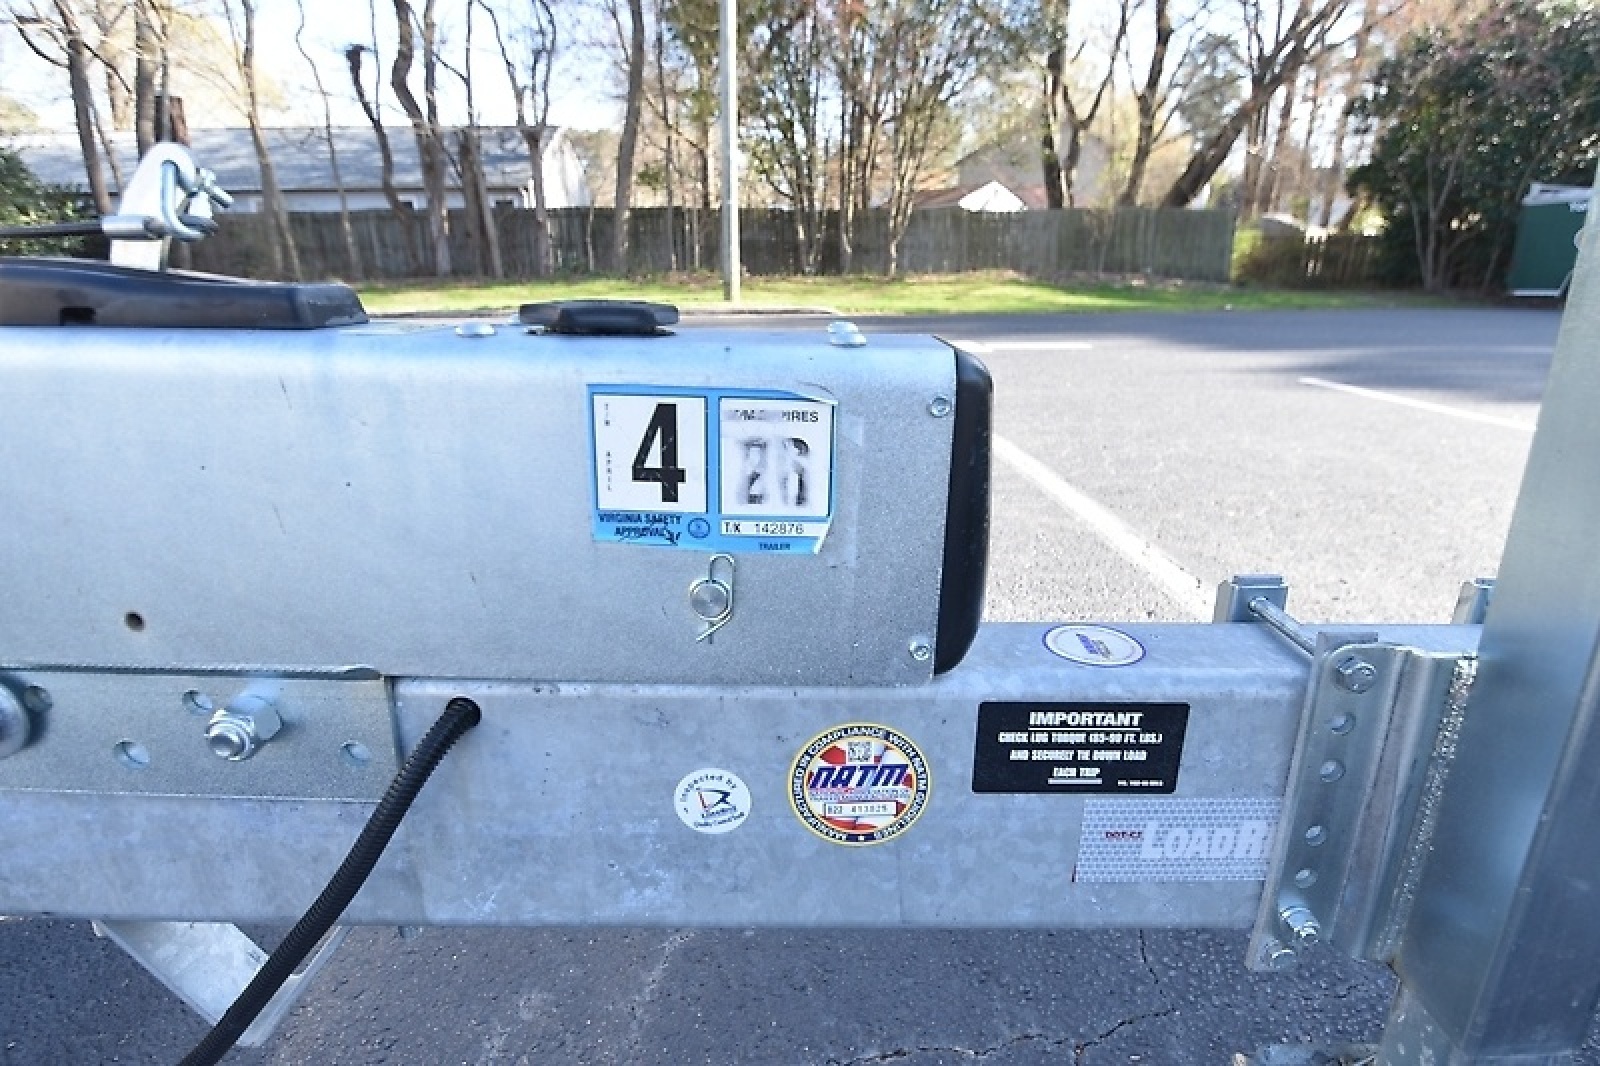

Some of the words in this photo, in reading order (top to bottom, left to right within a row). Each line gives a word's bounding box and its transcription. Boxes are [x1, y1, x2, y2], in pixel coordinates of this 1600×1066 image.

[631, 401, 686, 503] 4
[598, 513, 642, 523] VIRGINIA
[643, 513, 682, 525] SAFETY
[753, 523, 805, 535] 142876
[758, 541, 791, 551] TRAILER
[1029, 711, 1144, 726] IMPORTANT
[998, 731, 1029, 743] CHECK
[1030, 731, 1049, 743] LUG
[1051, 731, 1087, 744] TORQUE
[1009, 749, 1030, 761] AND
[1031, 749, 1075, 761] SECURELY
[1092, 749, 1121, 761] DOWN
[1123, 749, 1148, 761] LOAD
[1052, 766, 1077, 778] EACH
[1079, 766, 1101, 778] TRIP
